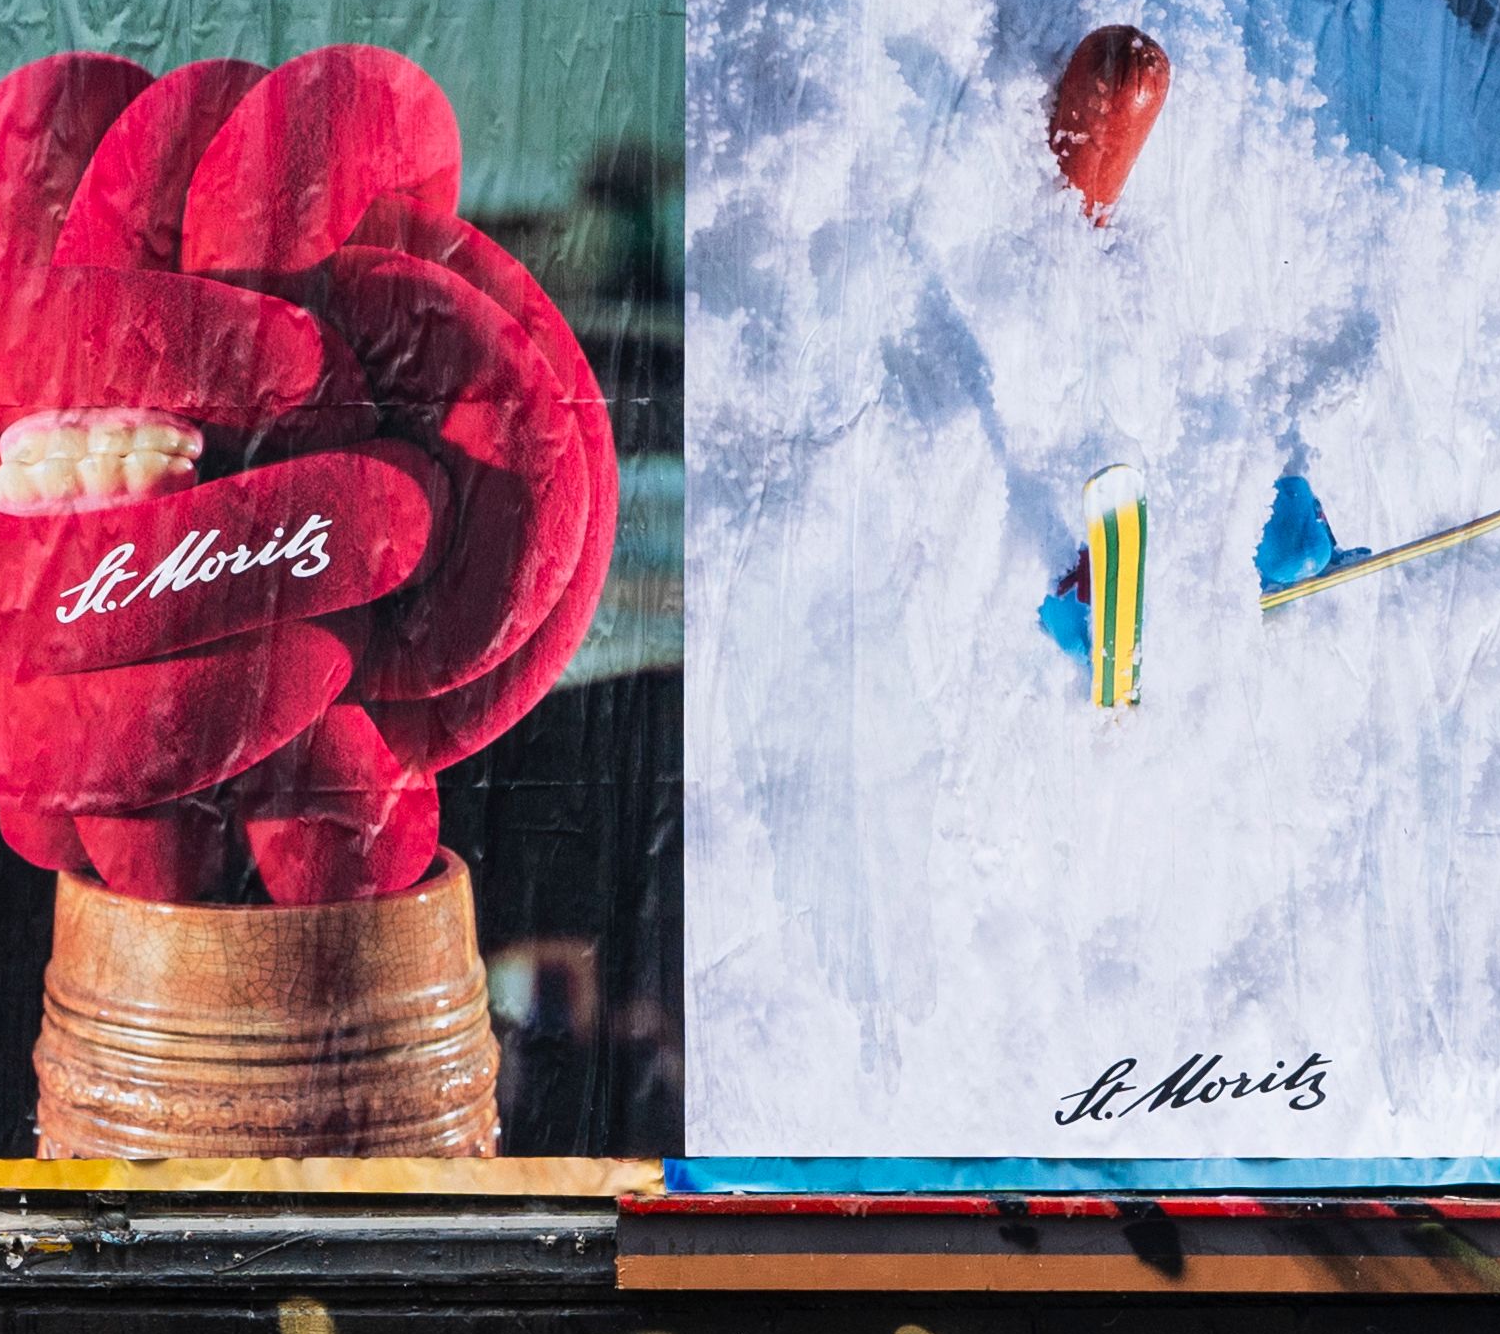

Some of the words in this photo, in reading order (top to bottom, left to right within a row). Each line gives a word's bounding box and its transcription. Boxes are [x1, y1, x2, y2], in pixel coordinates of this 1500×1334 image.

[56, 542, 139, 624] St.
[119, 513, 333, 608] Moritz
[1055, 1058, 1137, 1126] St.
[1118, 1052, 1332, 1118] Moritz
